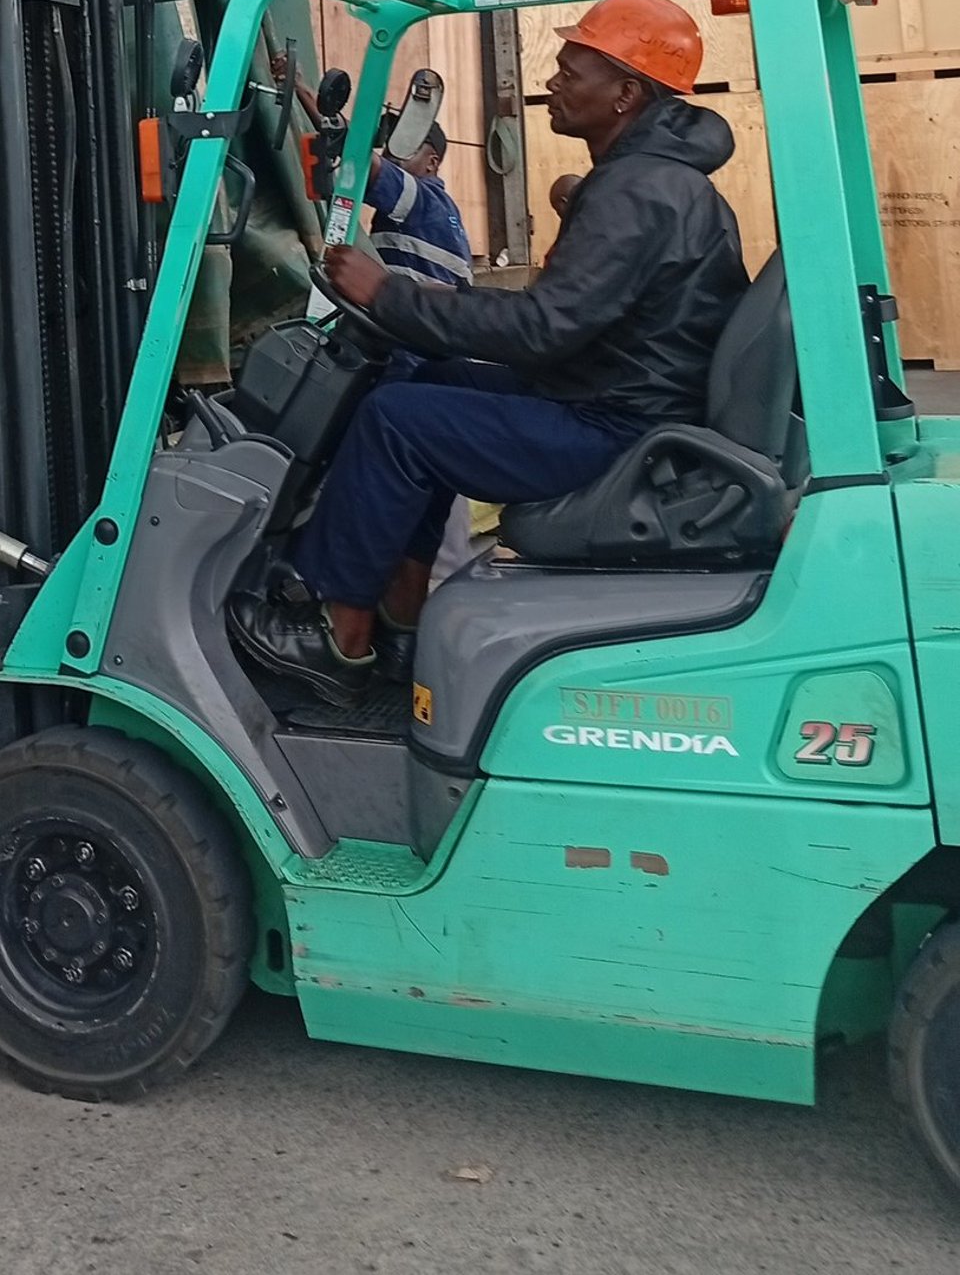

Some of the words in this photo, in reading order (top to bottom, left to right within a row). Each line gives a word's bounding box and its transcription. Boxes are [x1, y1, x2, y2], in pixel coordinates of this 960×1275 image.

[572, 691, 647, 721] SJFT
[656, 696, 722, 725] 0016
[795, 719, 878, 768] 25
